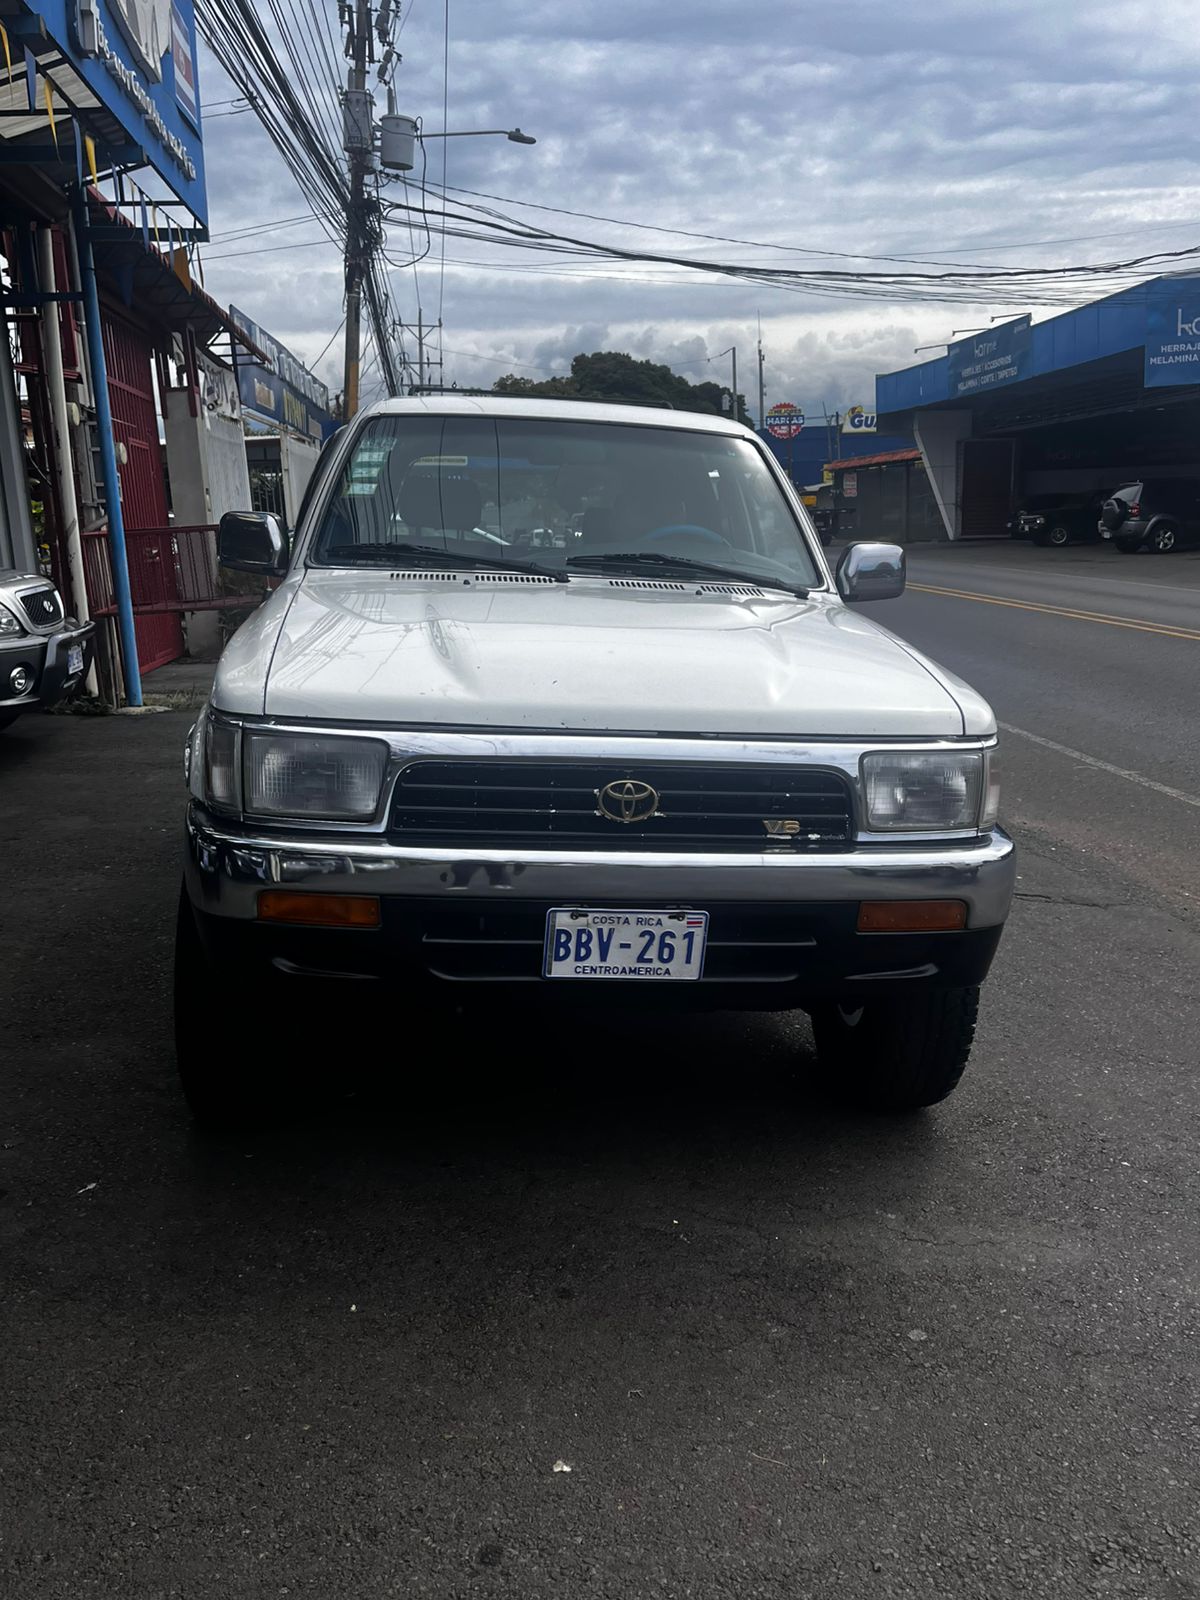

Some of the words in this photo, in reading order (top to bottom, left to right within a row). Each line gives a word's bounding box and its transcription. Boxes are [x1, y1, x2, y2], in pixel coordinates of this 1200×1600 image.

[1150, 353, 1199, 365] MELAMINA
[763, 820, 800, 833] V6
[592, 916, 631, 926] COSTA
[636, 917, 663, 927] RICA
[553, 928, 696, 964] BBV-261
[574, 965, 671, 976] CENTROAMERICA
